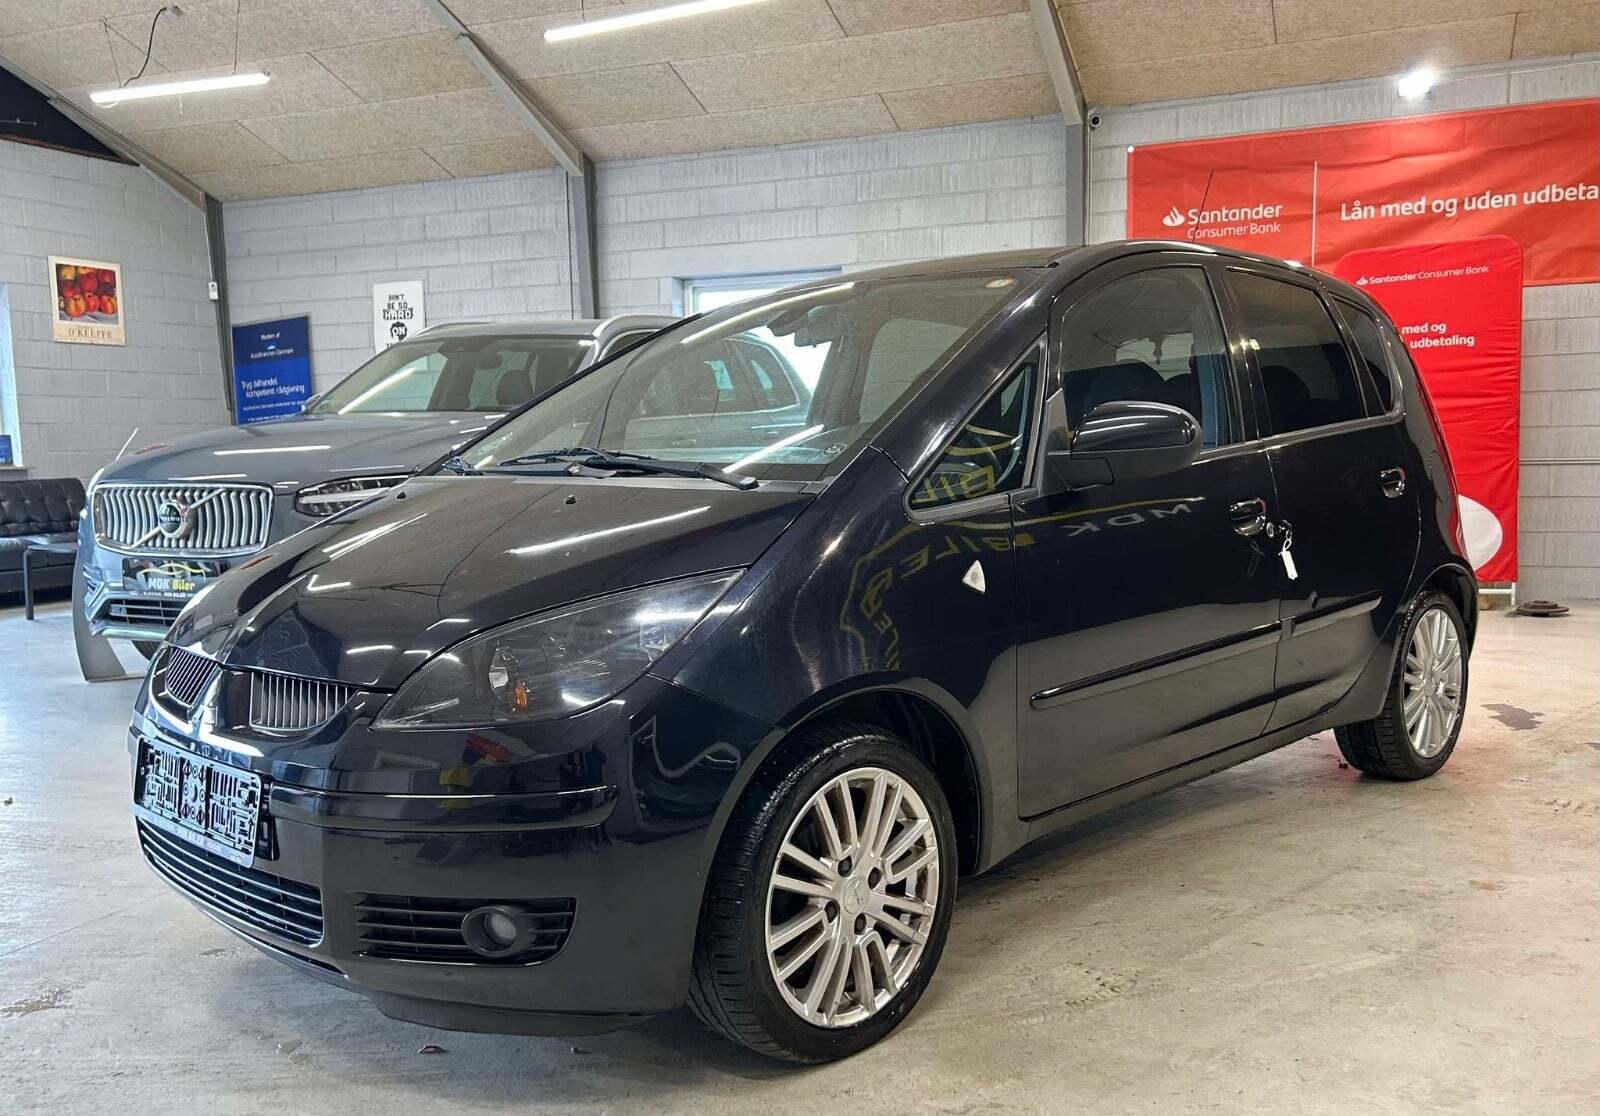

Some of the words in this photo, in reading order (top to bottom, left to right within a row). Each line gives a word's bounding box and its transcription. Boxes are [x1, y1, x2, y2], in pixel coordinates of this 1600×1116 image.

[1341, 200, 1375, 221] Lån
[1381, 196, 1426, 217] med
[1431, 198, 1458, 217] og
[1463, 190, 1517, 211] uden
[1523, 182, 1599, 204] udbeta
[1187, 204, 1283, 225] Santander
[1187, 224, 1248, 239] Consumer
[1249, 221, 1281, 235] Bank
[1368, 273, 1416, 285] Santander
[1418, 269, 1465, 279] Consumer
[1465, 265, 1489, 275] Bank
[383, 309, 413, 320] HARD
[392, 326, 406, 336] ON
[1401, 322, 1429, 334] med
[1430, 323, 1447, 334] og
[1409, 335, 1475, 349] udbetaling
[148, 577, 170, 590] MDK
[172, 578, 196, 591] Biler
